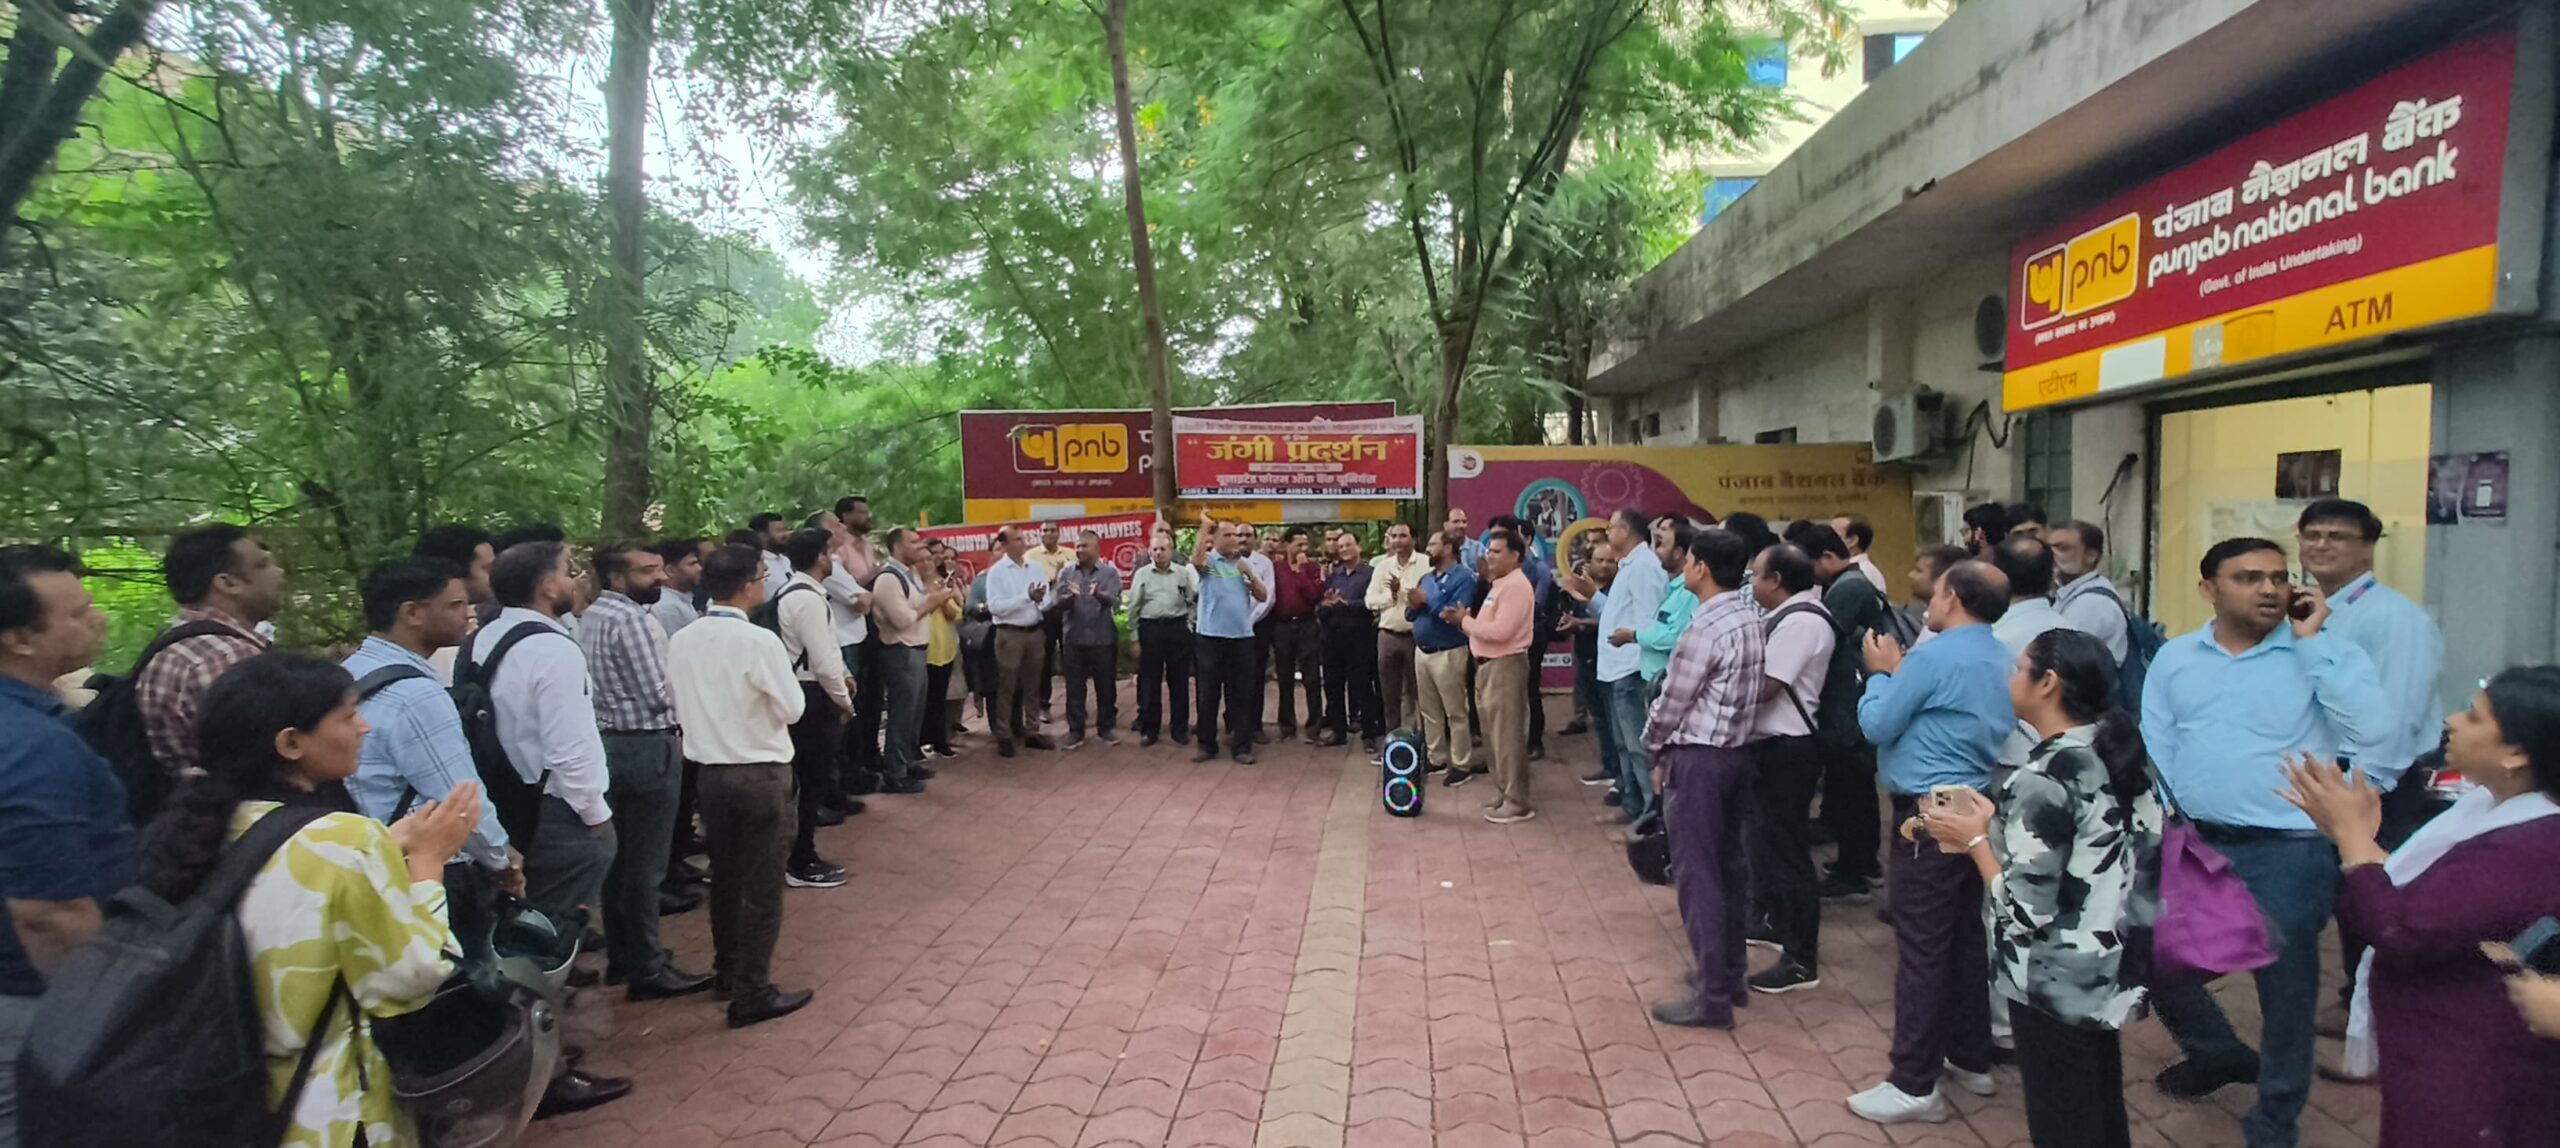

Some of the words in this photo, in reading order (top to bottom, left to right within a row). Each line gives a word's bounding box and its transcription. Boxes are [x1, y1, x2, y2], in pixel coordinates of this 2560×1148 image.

[2152, 187, 2234, 238] पंजाब
[2241, 132, 2368, 204] नैशनल
[2382, 95, 2462, 151] बैंक
[2148, 224, 2230, 287] punjab
[2233, 174, 2358, 250] national
[2364, 139, 2458, 204] bank
[2070, 233, 2130, 303] pnb
[2199, 275, 2231, 297] (Govt.
[2234, 267, 2247, 284] of
[2248, 258, 2277, 279] India
[2280, 233, 2363, 271] Undertaking)
[2324, 292, 2393, 334] ATM
[2038, 370, 2078, 398] एटीएम
[1065, 431, 1120, 465] pnb
[1204, 435, 1274, 461] जंगी
[1287, 435, 1388, 462] प्रदर्शन
